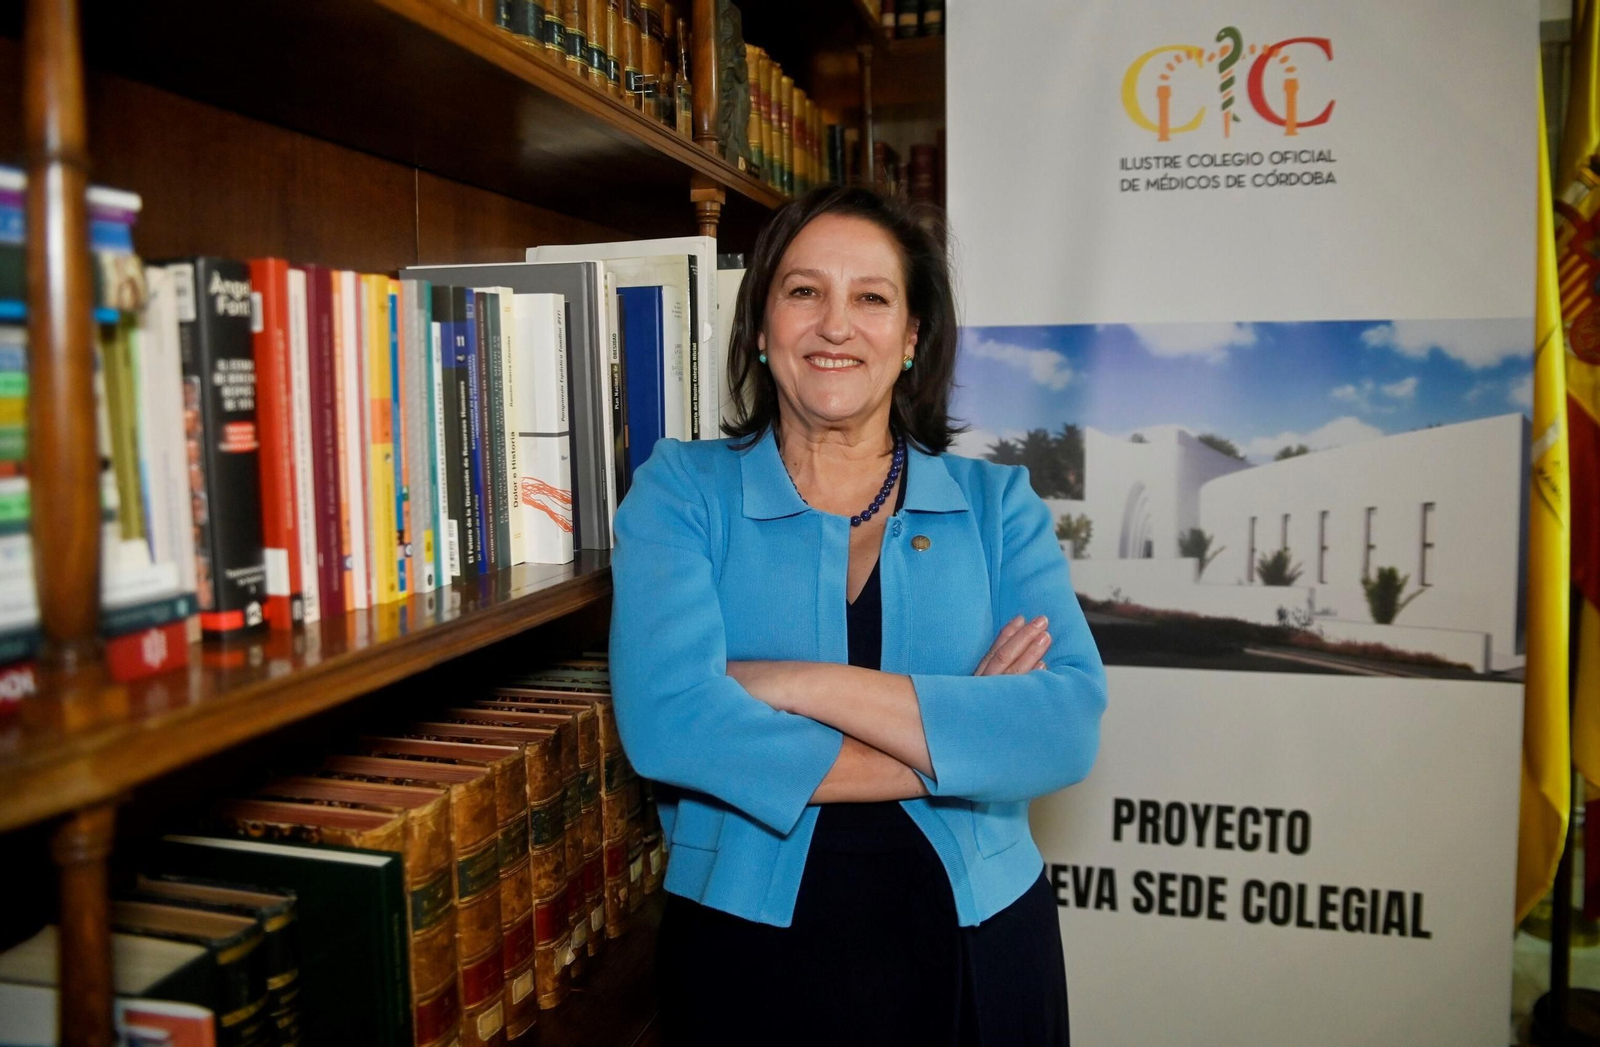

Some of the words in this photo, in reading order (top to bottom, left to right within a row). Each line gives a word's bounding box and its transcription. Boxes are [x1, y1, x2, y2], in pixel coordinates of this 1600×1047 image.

[1119, 154, 1182, 171] ILUSTRE
[1187, 152, 1264, 168] COLEGIO
[1269, 149, 1337, 165] OFICIAL
[1120, 176, 1140, 192] DE
[1146, 172, 1220, 191] MÉDICOS
[1226, 174, 1246, 188] DE
[1253, 169, 1337, 188] CÓRDOBA
[458, 381, 467, 418] Humanos
[460, 419, 468, 456] Recursos
[463, 458, 469, 468] de
[464, 469, 472, 507] Dirección
[465, 509, 472, 517] la
[466, 518, 472, 528] de
[468, 556, 475, 564] El
[1112, 798, 1312, 855] PROYECTO
[1044, 862, 1118, 912] EVA
[1132, 870, 1227, 922] SEDE
[1243, 879, 1432, 940] COLEGIAL
